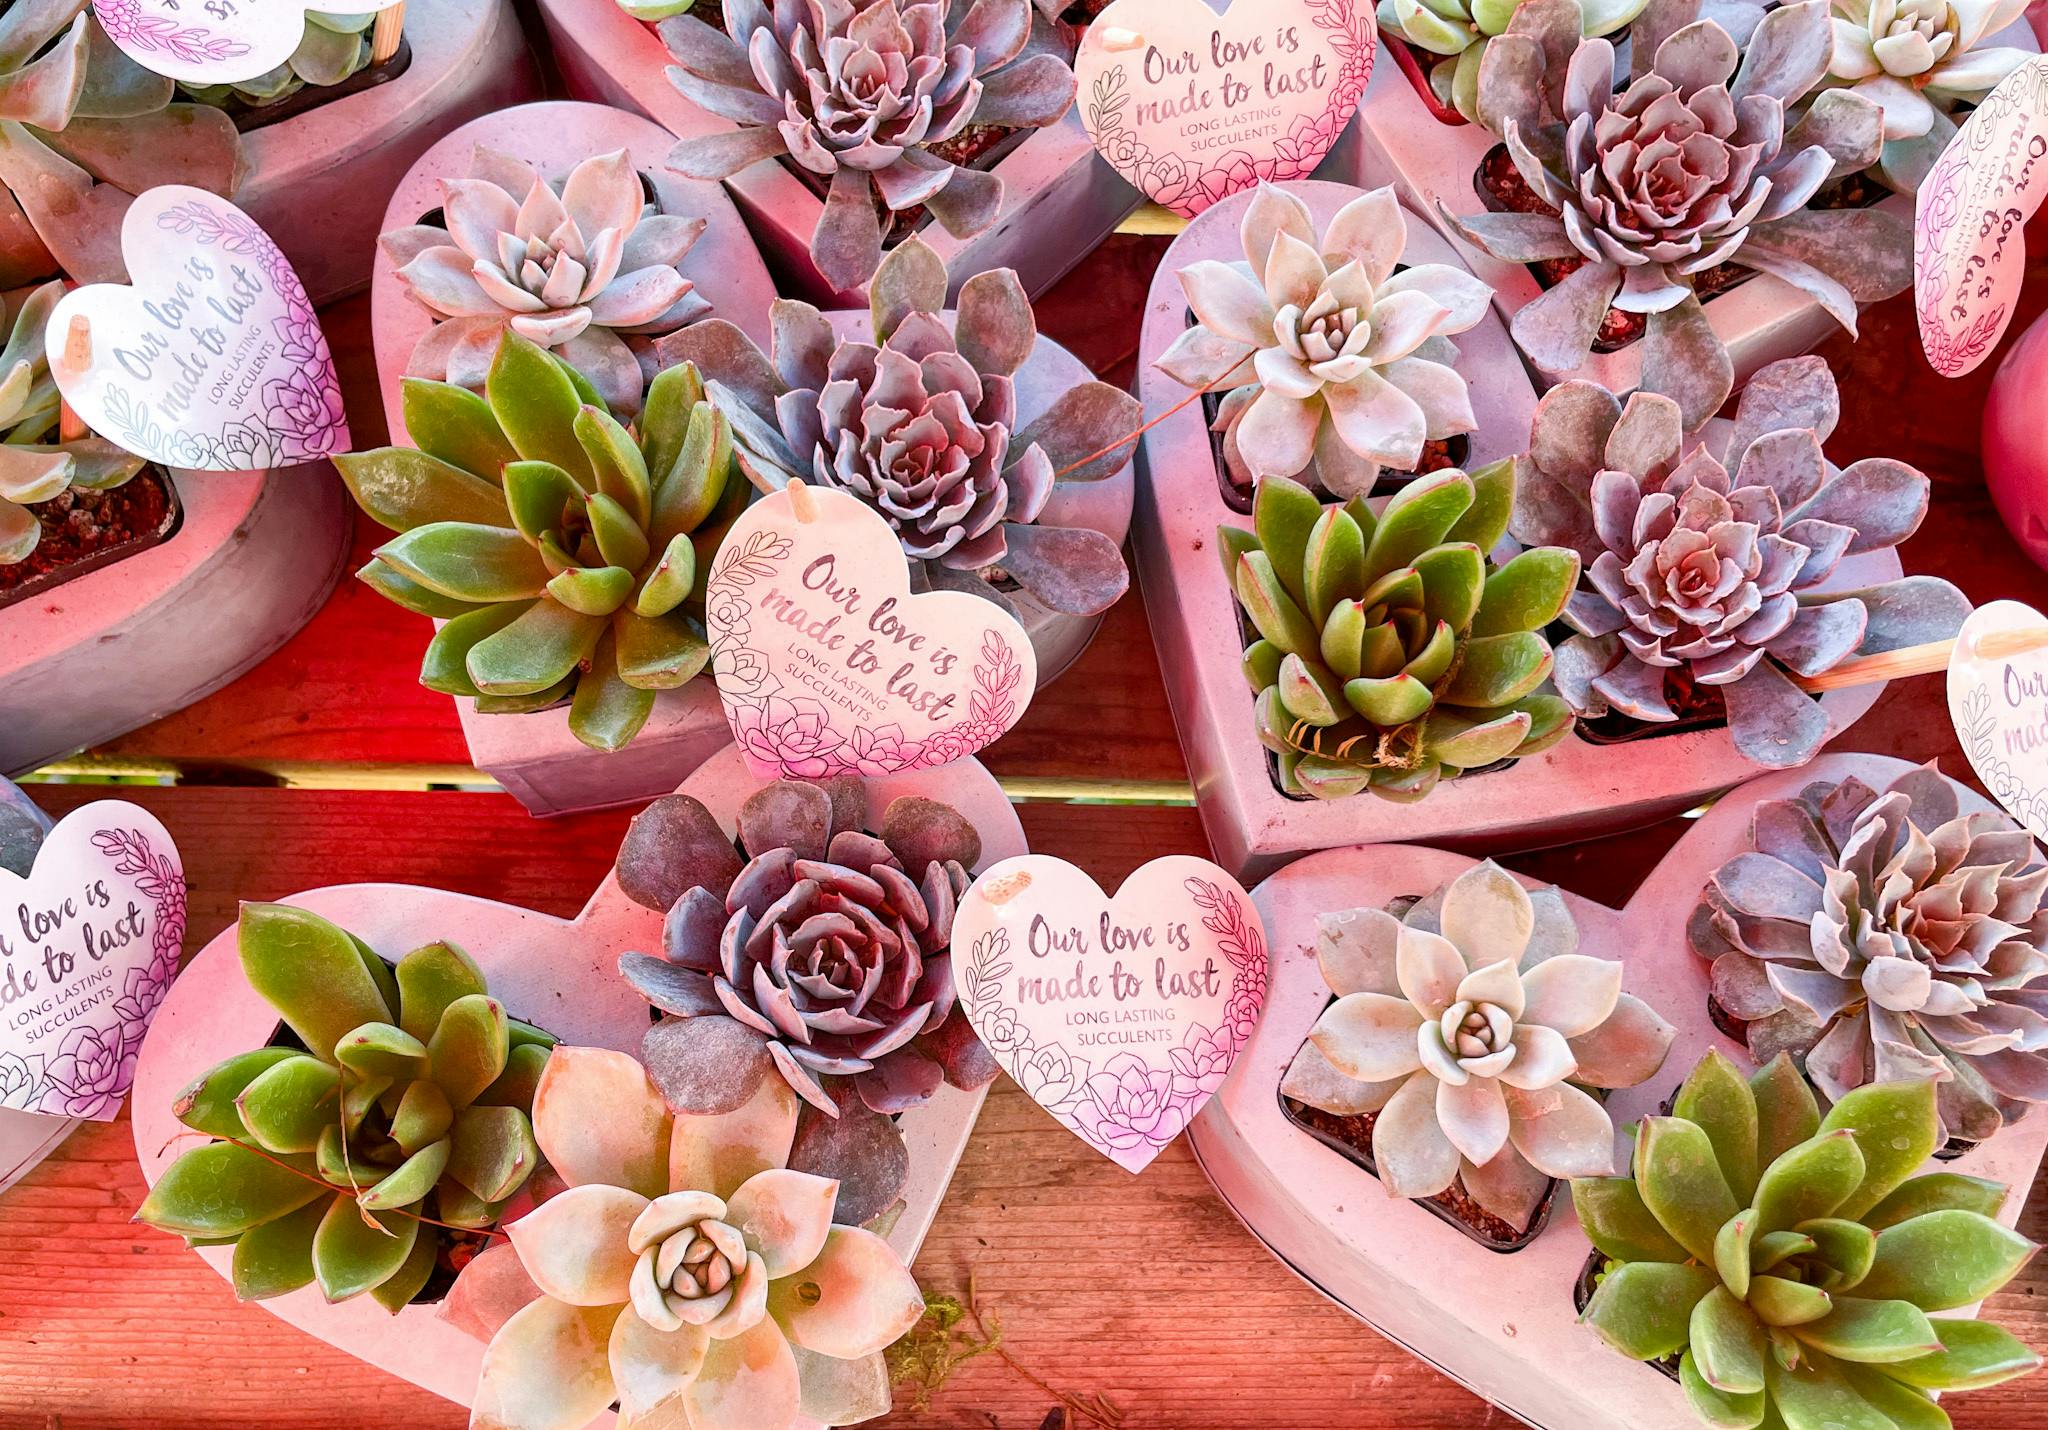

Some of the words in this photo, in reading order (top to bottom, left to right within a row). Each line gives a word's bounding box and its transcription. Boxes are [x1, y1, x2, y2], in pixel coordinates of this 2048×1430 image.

[1143, 45, 1200, 84] Our
[1211, 30, 1266, 69] love
[1276, 25, 1299, 53] is
[1136, 79, 1211, 126] made
[1220, 73, 1251, 108] to
[1264, 54, 1327, 100] last
[1180, 118, 1220, 137] LONG
[1224, 105, 1282, 127] LASTING
[1191, 124, 1278, 152] SUCCULENTS
[1980, 156, 2000, 201] LONG
[1993, 112, 2030, 199] made
[2015, 135, 2047, 196] Our
[1950, 162, 1988, 262] SUCCULENTS
[1956, 206, 1983, 269] LASTING
[1979, 208, 2000, 241] to
[1991, 208, 2022, 264] love
[206, 265, 263, 325] last
[1950, 255, 1985, 322] last
[1977, 275, 1994, 300] is
[112, 332, 169, 381] Our
[143, 280, 194, 330] love
[184, 256, 214, 281] is
[190, 324, 227, 356] to
[157, 351, 208, 423] made
[208, 371, 233, 406] LONG
[227, 325, 262, 374] LASTING
[228, 341, 276, 410] SUCCULENTS
[802, 553, 862, 615] Our
[869, 597, 926, 651] love
[930, 647, 958, 675] is
[760, 587, 845, 651] made
[846, 639, 882, 674] to
[886, 662, 956, 721] last
[787, 642, 829, 674] LONG
[831, 664, 889, 712] LASTING
[784, 663, 873, 722] SUCCULENTS
[18, 897, 78, 944] love
[86, 880, 110, 908] is
[42, 945, 76, 984] to
[83, 901, 145, 961] last
[1028, 914, 1088, 958] Our
[1100, 911, 1155, 951] love
[1167, 921, 1190, 951] is
[9, 998, 53, 1032] LONG
[57, 965, 113, 1005] LASTING
[1018, 960, 1102, 1005] made
[1109, 961, 1143, 1002] to
[1154, 957, 1220, 999] last
[25, 985, 114, 1044] SUCCULENTS
[1066, 1011, 1109, 1026] LONG
[1115, 1008, 1176, 1024] LASTING
[1078, 1029, 1173, 1046] SUCCULENTS
